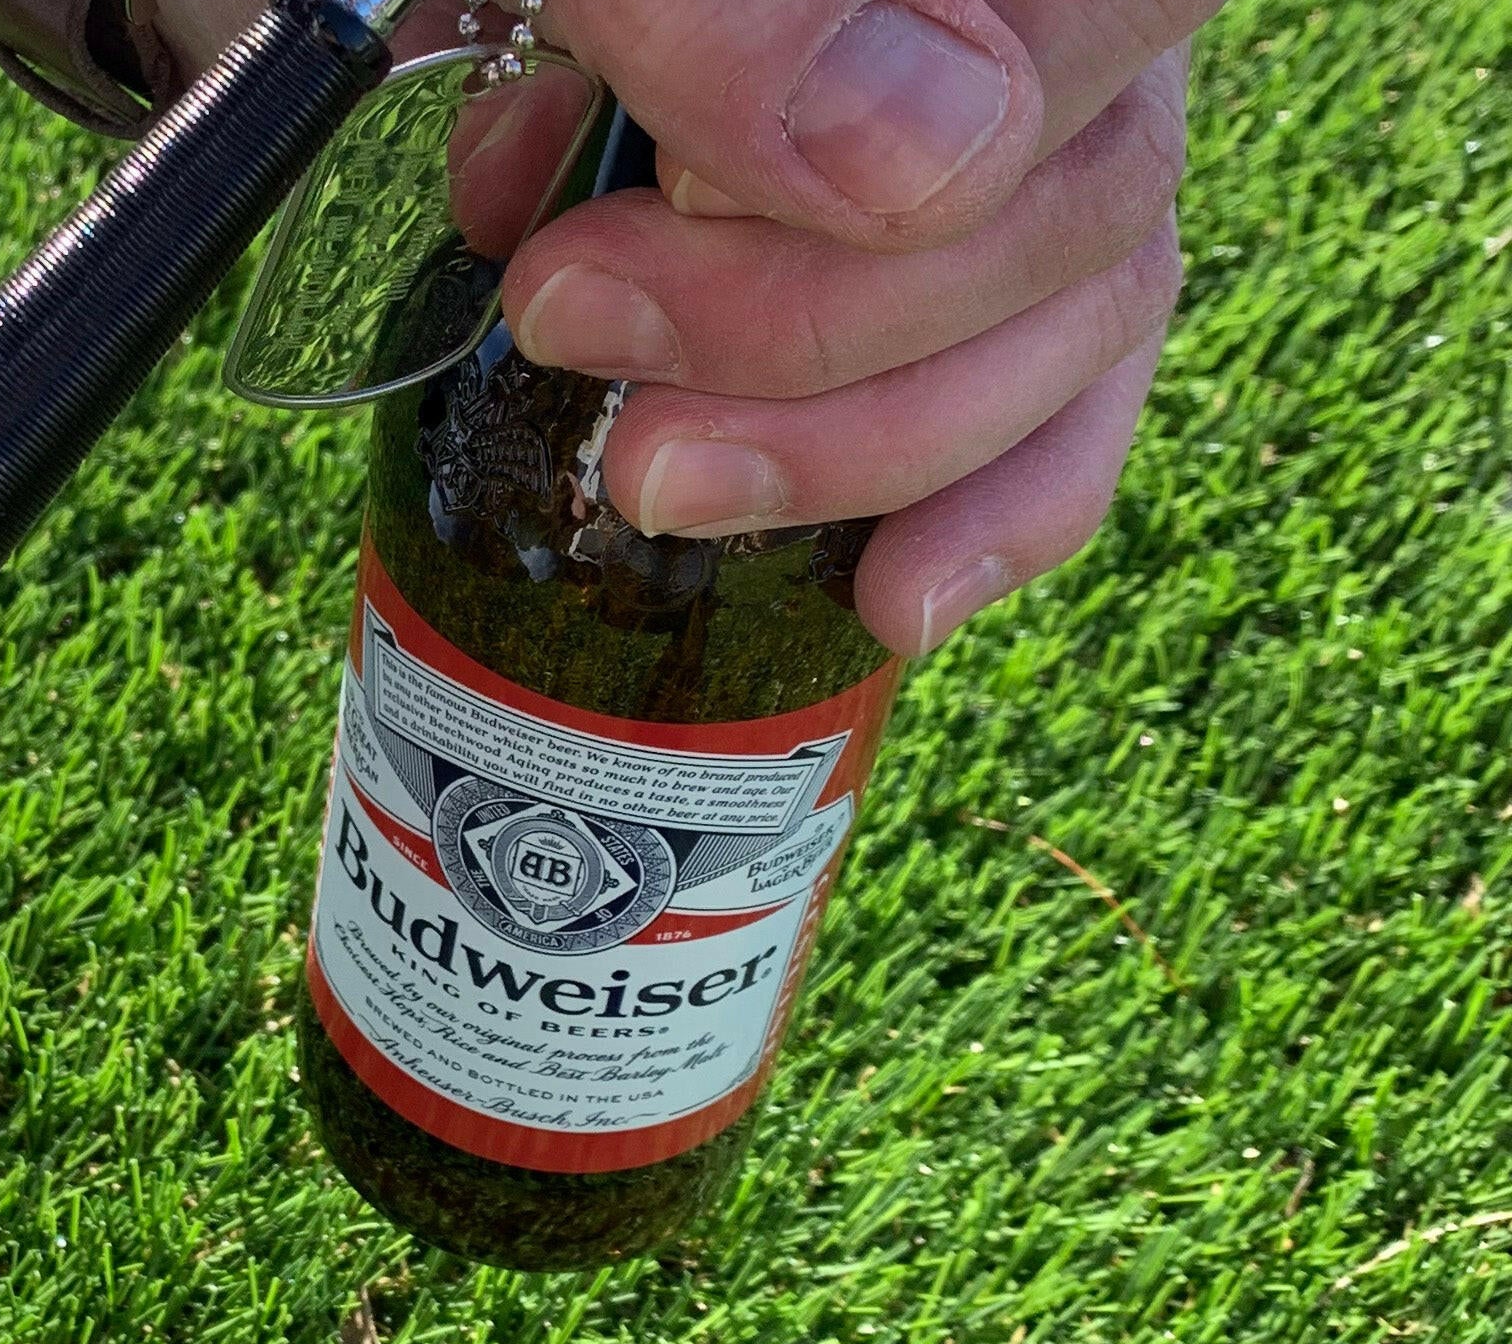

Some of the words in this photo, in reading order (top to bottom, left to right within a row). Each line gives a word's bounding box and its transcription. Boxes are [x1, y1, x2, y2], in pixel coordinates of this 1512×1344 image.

[382, 652, 397, 673] This
[399, 668, 406, 679] is
[408, 672, 423, 690] the
[425, 683, 467, 715] famous
[470, 709, 544, 746] Budweiser
[547, 738, 582, 759] beer.
[587, 751, 609, 766] We
[612, 754, 656, 773] know
[658, 765, 677, 777] of
[676, 769, 697, 780] no
[699, 769, 744, 782] brand
[743, 769, 804, 784] produced
[383, 688, 426, 721] exclusive
[429, 714, 502, 758] Beechwood
[505, 752, 551, 777] Aging
[555, 771, 631, 797] produces
[634, 790, 645, 800] a
[648, 792, 690, 807] taste,
[694, 797, 705, 807] a
[707, 798, 787, 810] smoothness
[394, 679, 412, 699] any
[413, 692, 443, 716] other
[445, 705, 489, 738] brewer
[492, 733, 535, 757] which
[538, 750, 577, 771] costs
[581, 765, 600, 776] so
[603, 770, 647, 787] much
[651, 778, 669, 790] to
[672, 782, 711, 795] brew
[712, 784, 739, 796] and
[742, 786, 769, 799] age.
[771, 784, 796, 796] Our
[401, 715, 409, 727] a
[410, 719, 479, 764] drinkability
[483, 757, 508, 776] you
[512, 765, 539, 786] will
[542, 776, 574, 798] find
[578, 790, 594, 803] in
[597, 796, 619, 808] no
[623, 801, 665, 817] other
[667, 807, 700, 821] beer
[702, 811, 718, 822] at
[720, 813, 745, 825] any
[475, 803, 511, 824] UNITED
[392, 837, 429, 872] SINCE
[470, 868, 490, 889] THE
[600, 834, 636, 867] STATES
[750, 866, 803, 894] LAGER
[335, 796, 778, 1019] Budweiser
[504, 924, 559, 949] AMERICA
[593, 906, 614, 923] OF
[655, 929, 692, 943] 1876
[334, 918, 381, 987] Choicest
[425, 1009, 479, 1055] Rice
[481, 1051, 532, 1072] and
[529, 1061, 590, 1082] Best
[347, 920, 402, 983] Brewed
[400, 982, 423, 1003] by
[426, 1002, 461, 1024] our
[462, 1022, 548, 1055] original
[545, 1047, 624, 1063] process
[624, 1045, 682, 1067] from
[685, 1031, 717, 1052] the
[391, 943, 460, 1000] KING
[477, 1001, 523, 1022] OF
[541, 1021, 656, 1038] BEERS
[365, 995, 423, 1049] BREWED
[427, 1049, 463, 1073] AND
[468, 1069, 554, 1101] BOTTLED
[559, 1094, 579, 1104] IN
[585, 1094, 623, 1104] THE
[627, 1089, 665, 1103] USA
